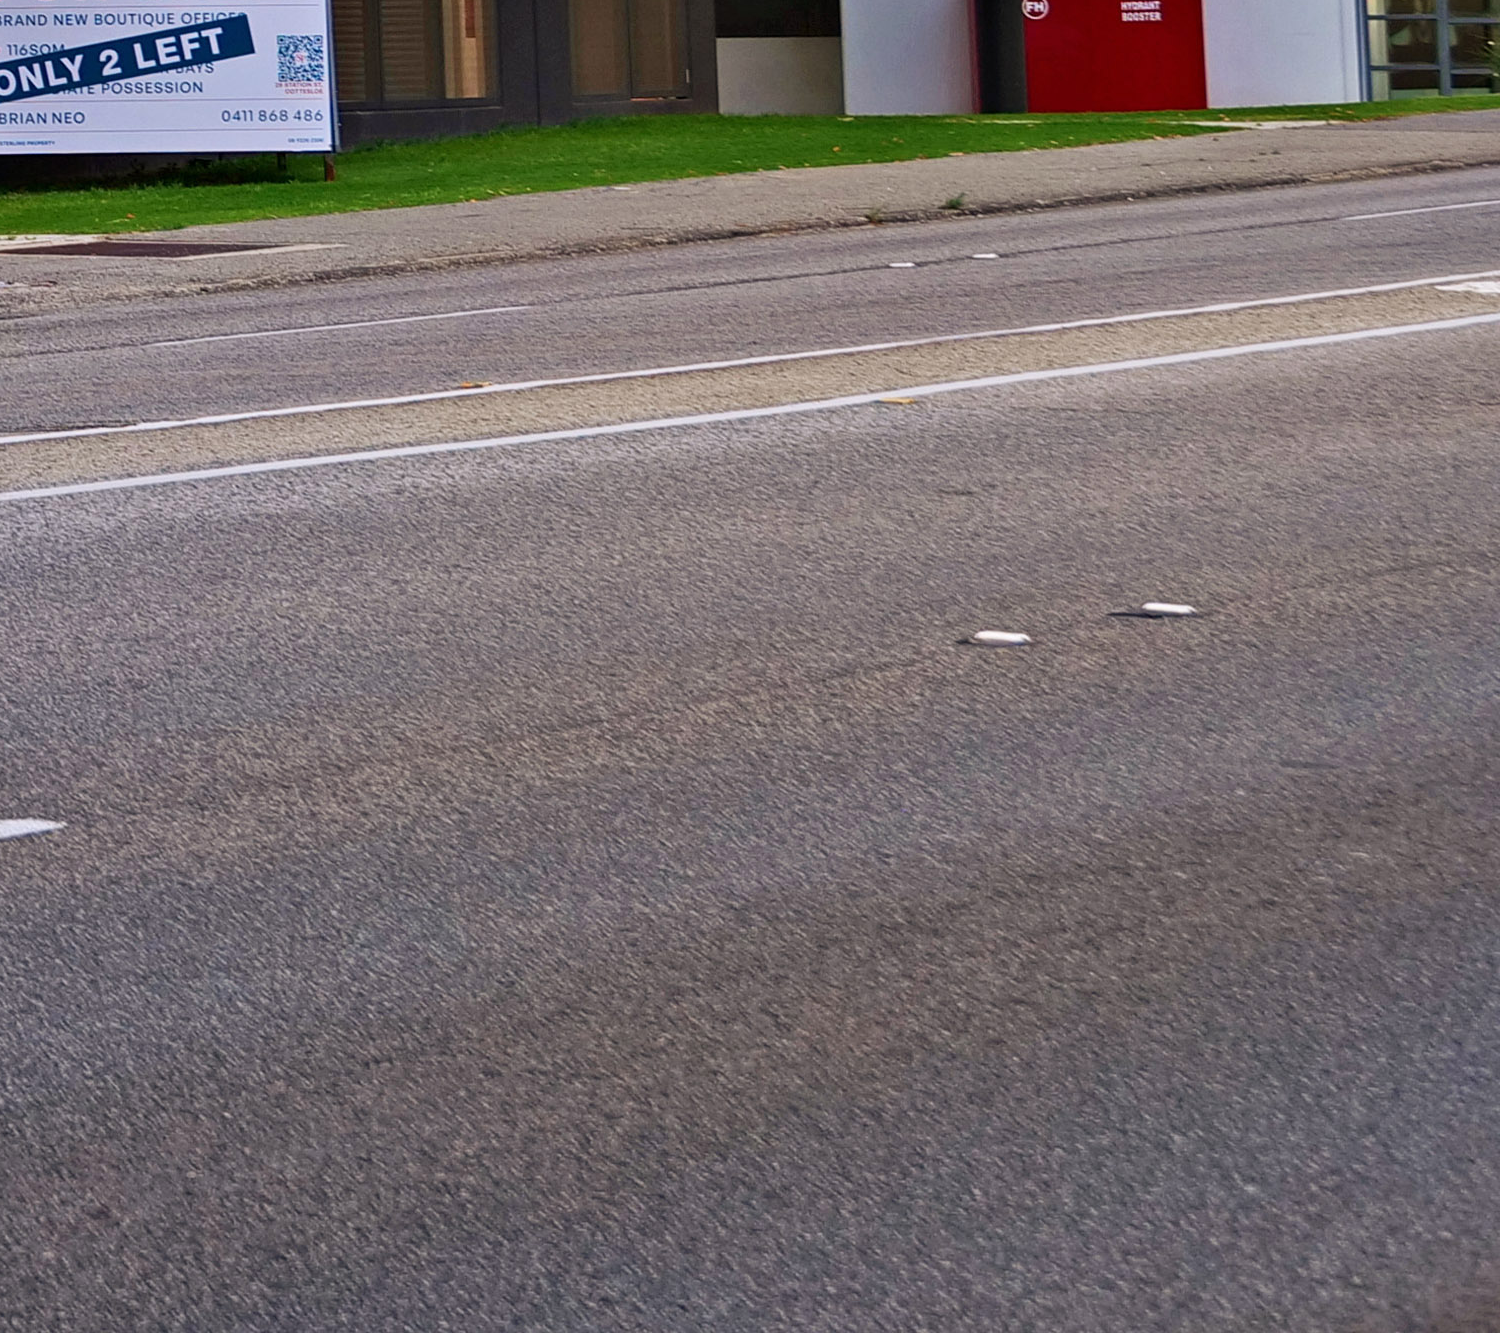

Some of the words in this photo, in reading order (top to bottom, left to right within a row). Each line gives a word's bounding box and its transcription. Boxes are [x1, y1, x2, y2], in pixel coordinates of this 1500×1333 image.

[1025, 1, 1044, 13] FH
[1121, 1, 1161, 11] HYDRANT
[53, 14, 88, 26] NEW
[94, 13, 175, 27] BOUTIQUE
[180, 12, 247, 25] OFFIC
[1121, 12, 1162, 21] BOOSTER
[99, 49, 122, 77] 2
[133, 27, 224, 70] LEFT
[101, 81, 203, 94] POSSESSION
[52, 112, 85, 124] NEO
[221, 110, 254, 122] 0411
[258, 109, 288, 122] 868
[293, 109, 324, 122] 486
